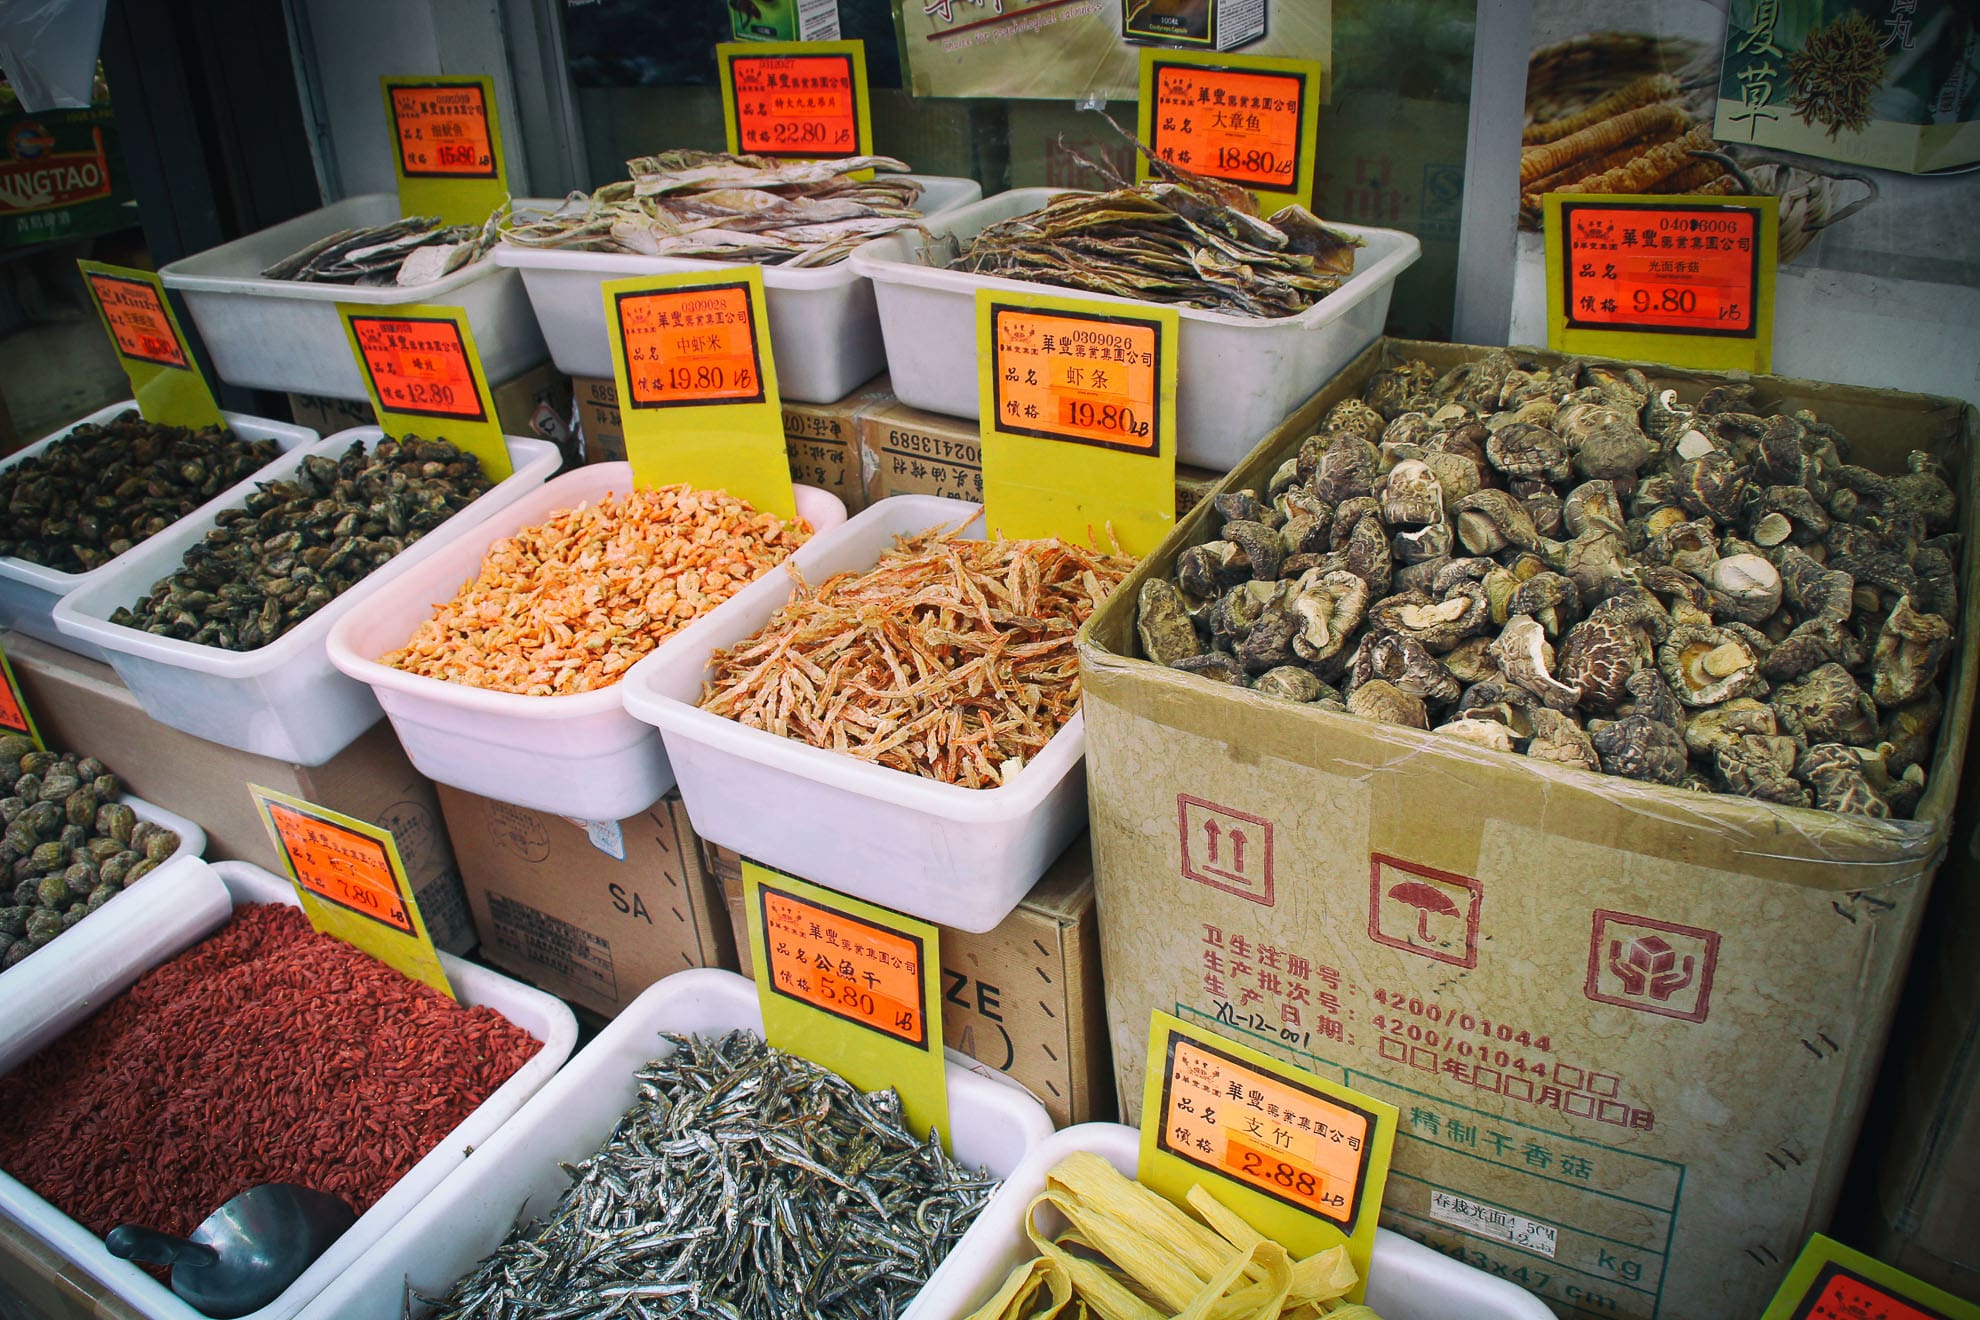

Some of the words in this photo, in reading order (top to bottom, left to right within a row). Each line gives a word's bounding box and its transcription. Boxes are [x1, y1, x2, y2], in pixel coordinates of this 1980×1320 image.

[743, 102, 767, 116] 品名
[1163, 117, 1193, 134] 品名
[1579, 263, 1617, 280] 品名
[1648, 261, 1700, 273] 光面香菇
[1632, 288, 1697, 314] 9.80
[633, 346, 659, 361] 品名
[677, 334, 722, 353] 中虾米
[1072, 329, 1133, 350] 0309026
[669, 366, 724, 390] 19.80
[1005, 367, 1038, 386] 品名
[1067, 366, 1109, 389] 虾条
[407, 383, 455, 405] 12.80
[1068, 401, 1135, 432] 19.80
[1131, 421, 1149, 437] LB
[608, 882, 653, 925] SA
[777, 942, 808, 964] 品名
[820, 977, 874, 1016] 5.80
[1201, 923, 1357, 996] 卫生注册号:
[1372, 987, 1551, 1052] 4200/01044
[1202, 949, 1356, 1021] 生产批次号:
[1177, 1096, 1217, 1126] 品名
[1242, 1116, 1294, 1149] 支竹
[1409, 1106, 1596, 1182] 精制干香菇
[1241, 1151, 1317, 1197] 2.88
[1597, 1248, 1643, 1282] kg
[1565, 1283, 1617, 1312] cm
